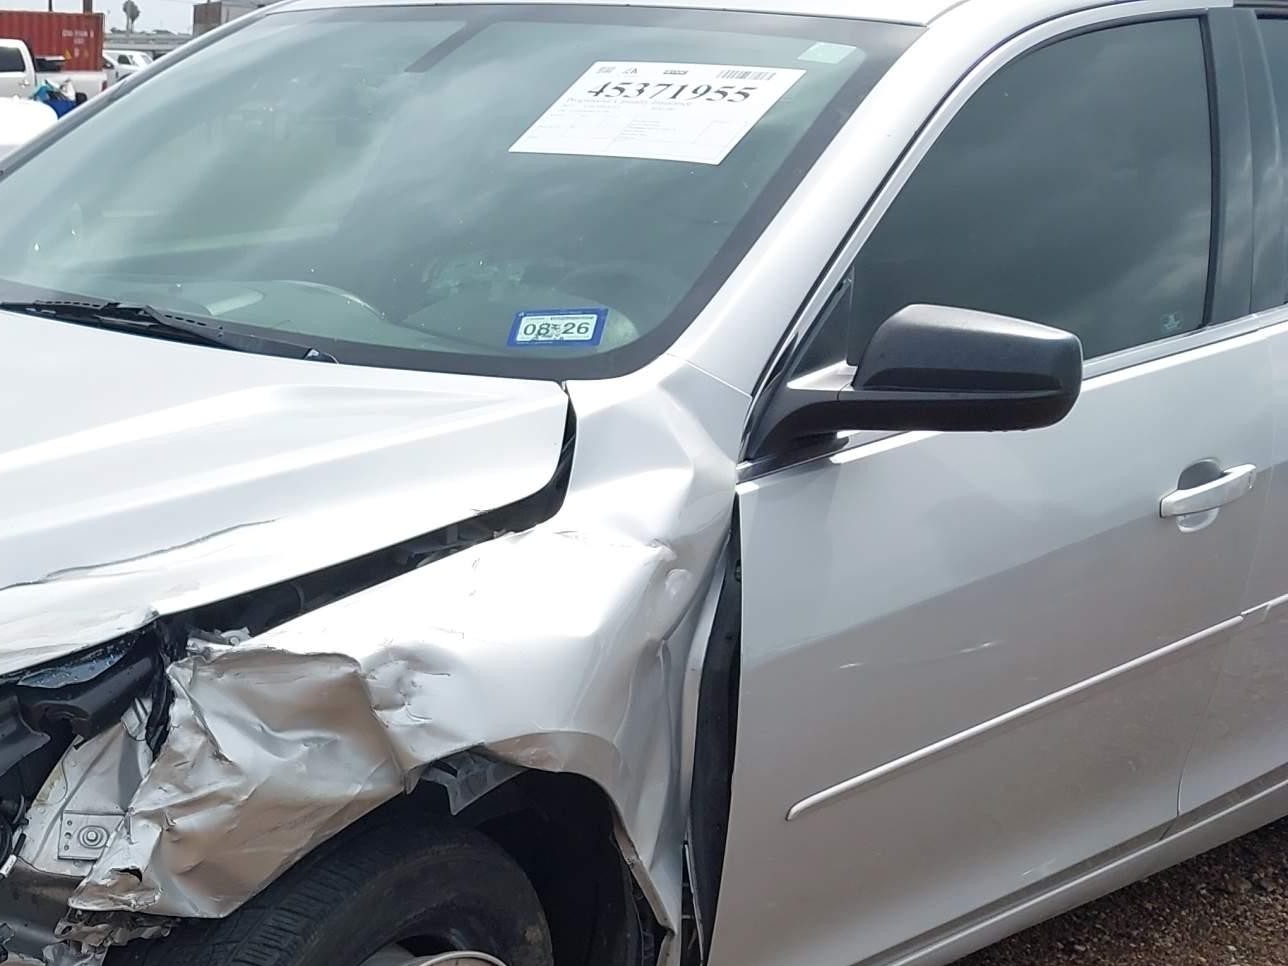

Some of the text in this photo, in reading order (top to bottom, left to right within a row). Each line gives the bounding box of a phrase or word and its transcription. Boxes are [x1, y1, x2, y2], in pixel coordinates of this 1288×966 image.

[587, 81, 758, 103] 45371955
[523, 321, 591, 336] 08 26
